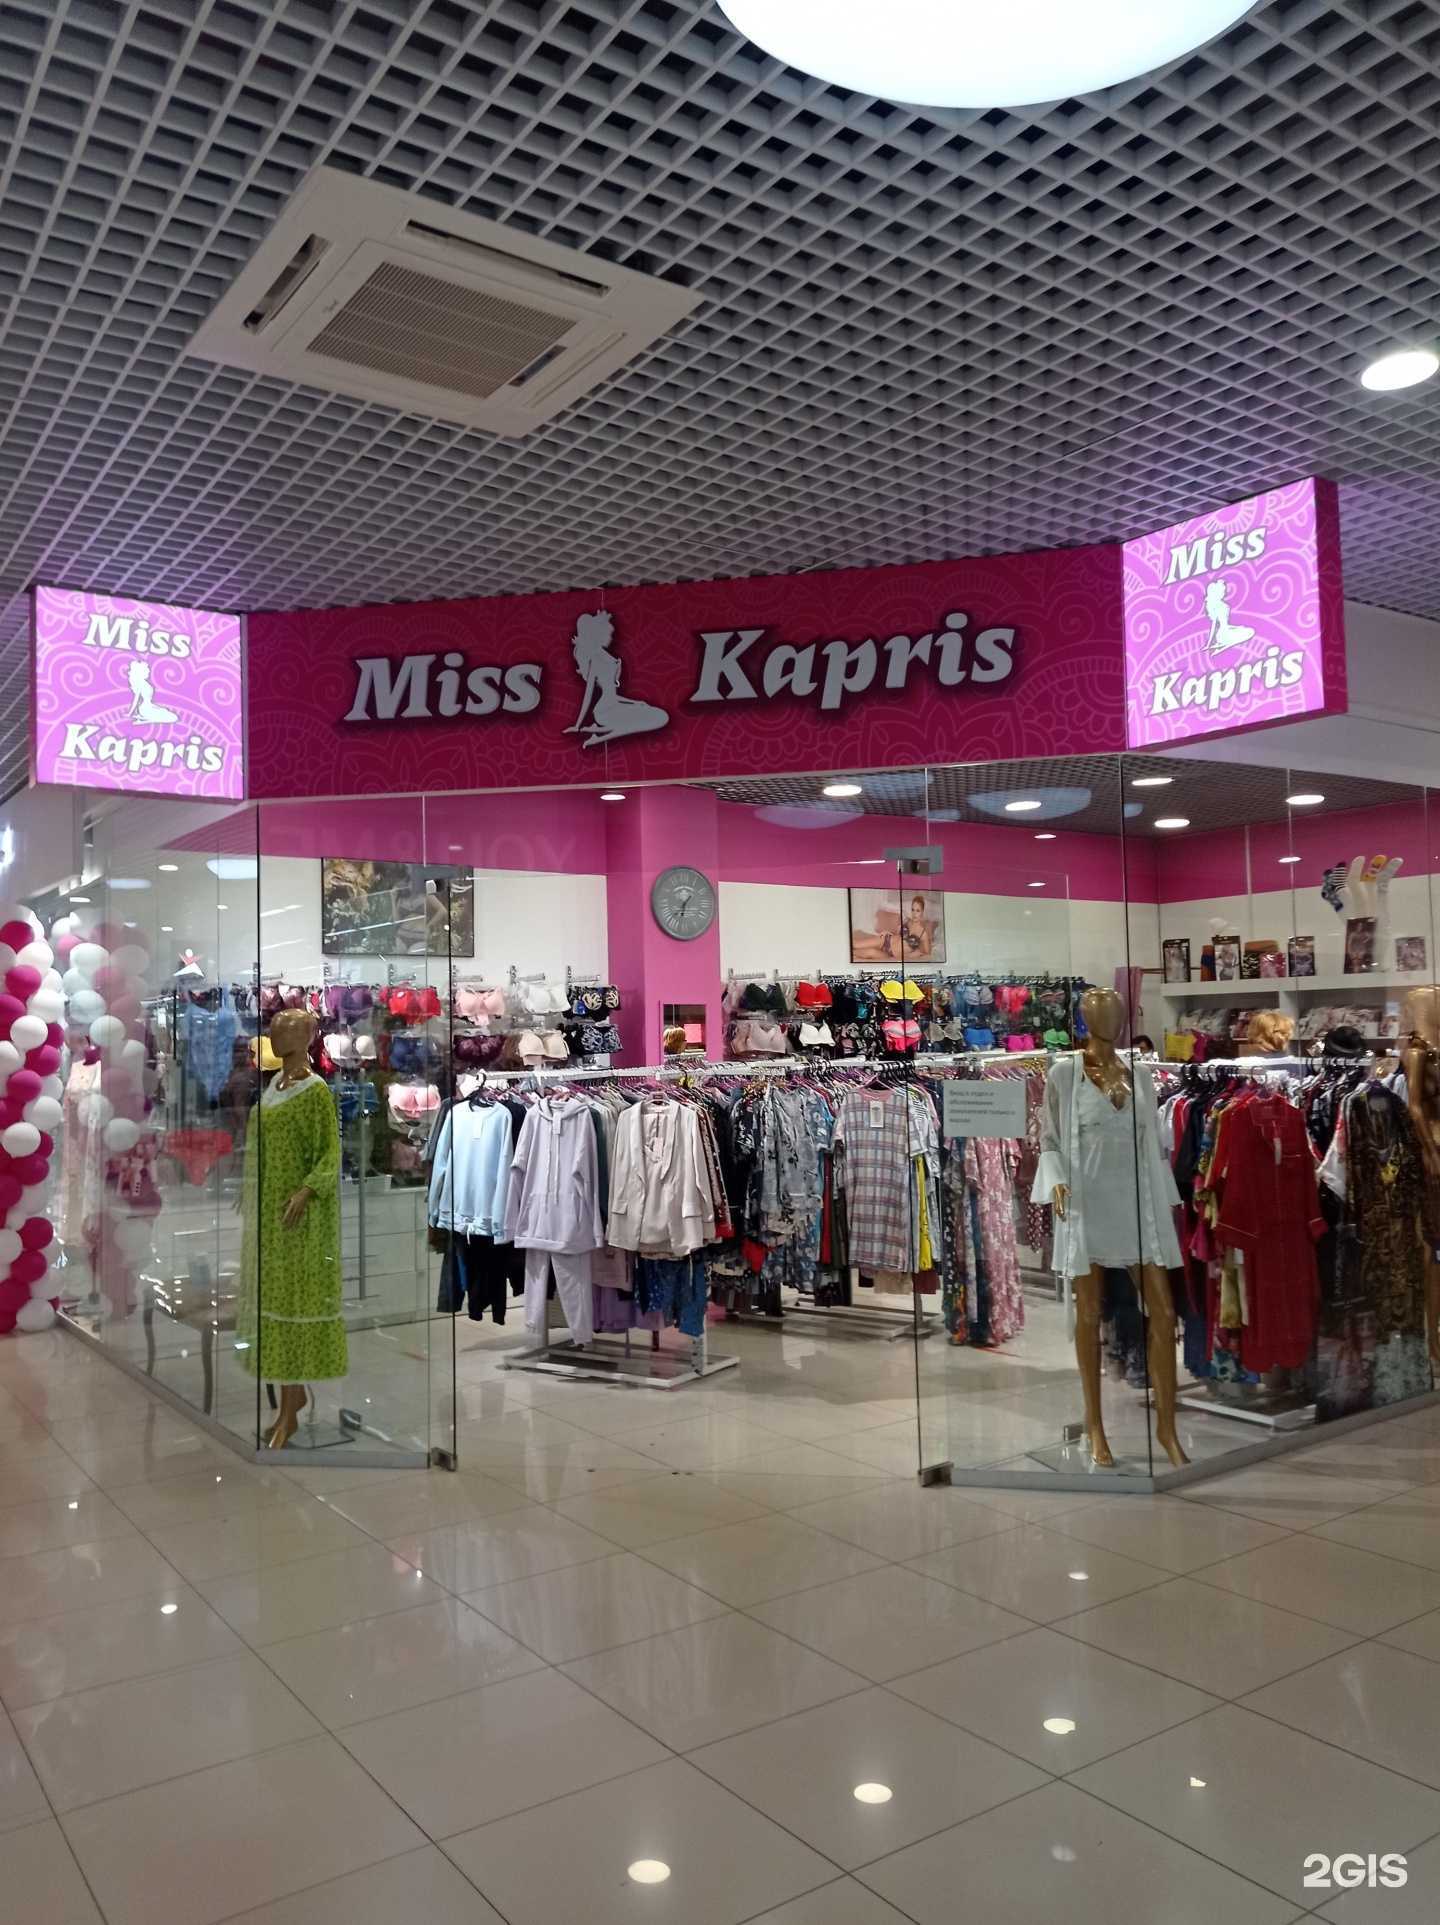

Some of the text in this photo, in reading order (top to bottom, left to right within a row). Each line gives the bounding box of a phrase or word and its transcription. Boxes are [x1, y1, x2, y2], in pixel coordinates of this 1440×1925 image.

[1163, 527, 1267, 586] Miss
[82, 613, 192, 659] Miss
[343, 612, 1015, 721] Miss Kapris
[1148, 646, 1304, 716] Kapris
[58, 722, 224, 773] Kapris
